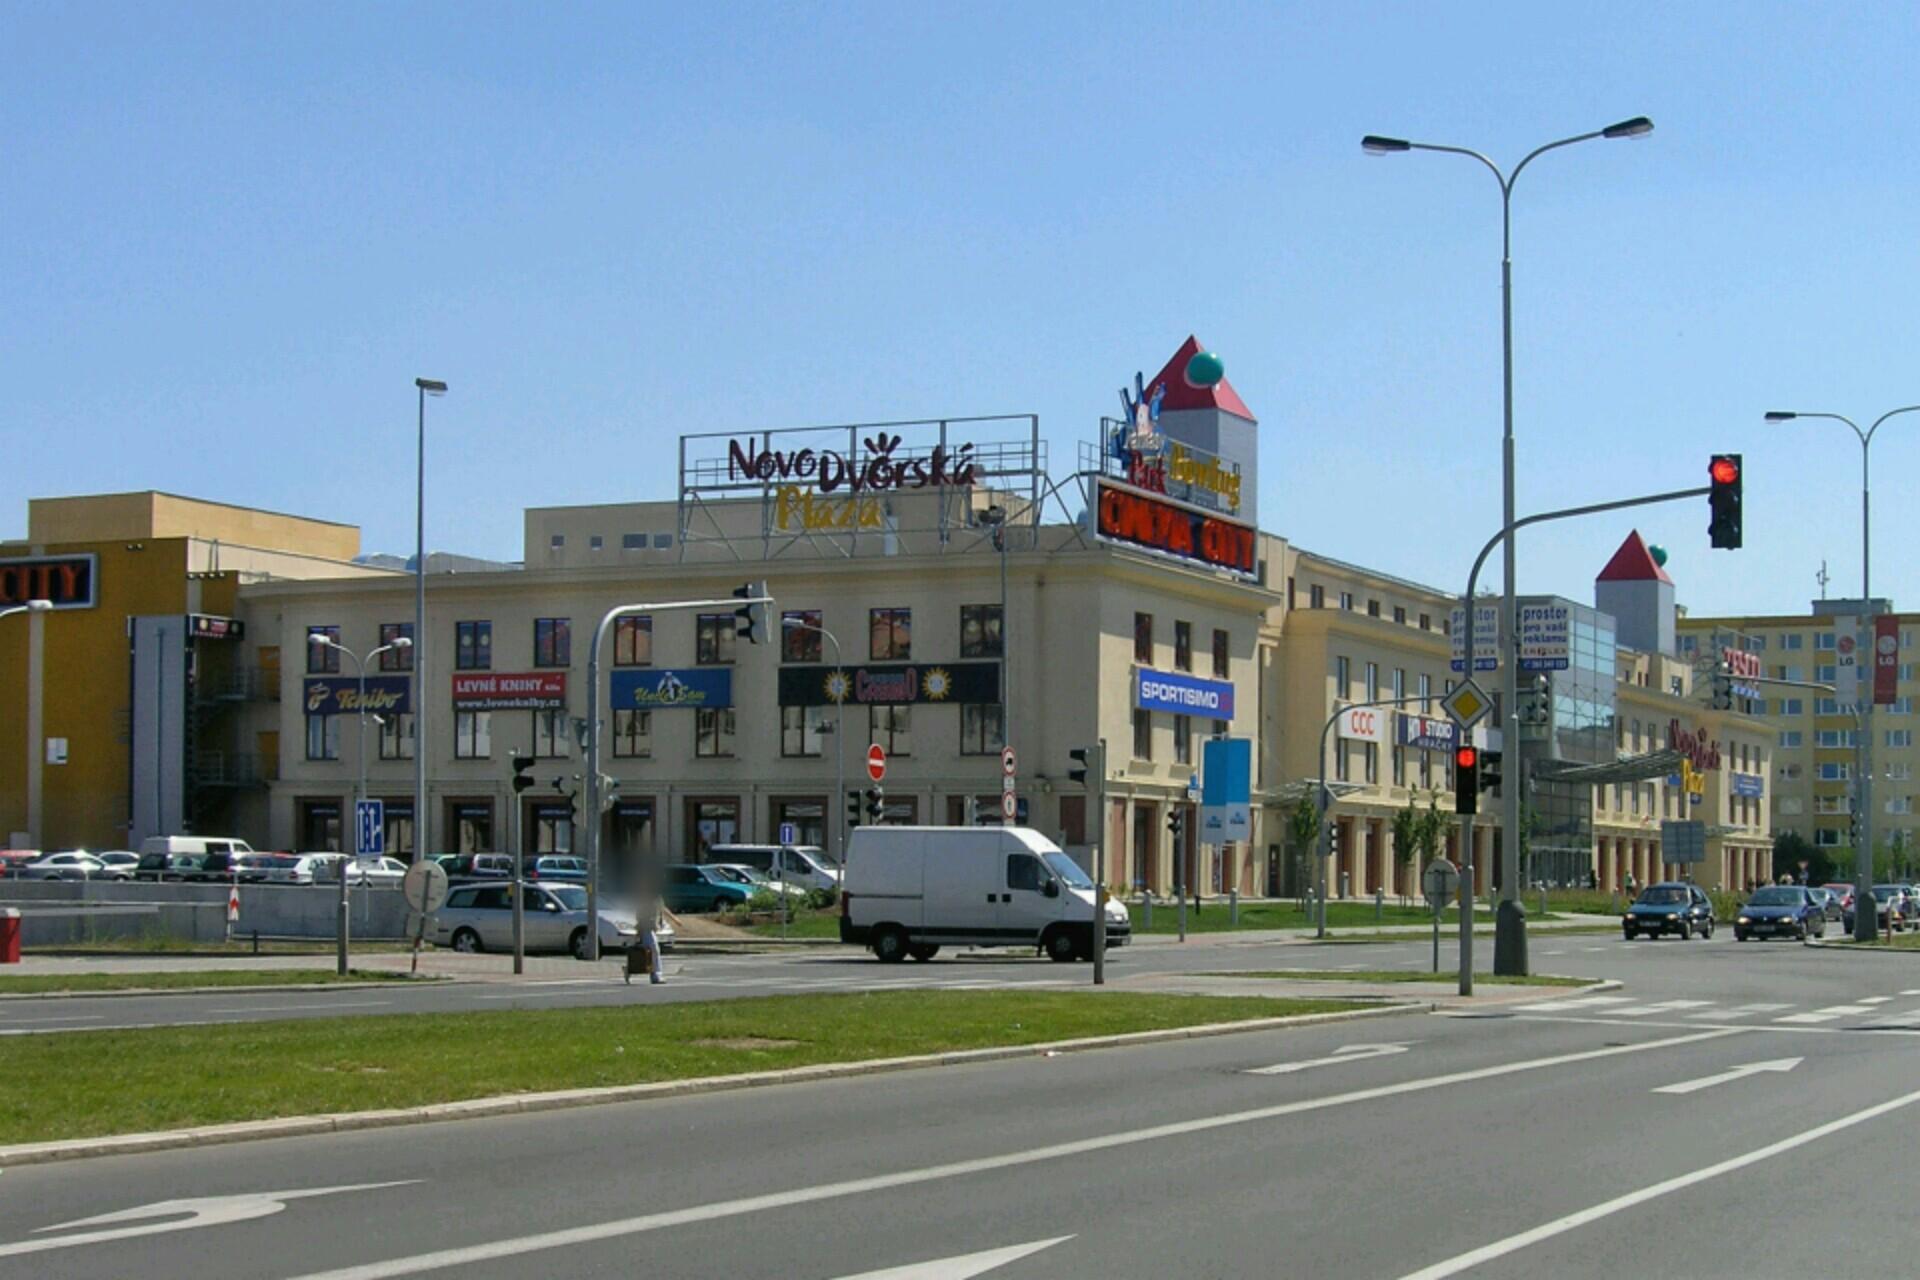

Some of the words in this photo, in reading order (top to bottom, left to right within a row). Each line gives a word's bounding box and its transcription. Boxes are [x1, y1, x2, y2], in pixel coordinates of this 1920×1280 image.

[1523, 608, 1567, 622] prostor
[1523, 623, 1541, 633] pro
[1523, 633, 1567, 643] reklamu
[1839, 657, 1854, 666] LG
[1878, 657, 1895, 666] LG
[456, 676, 497, 693] LEVNÉ
[500, 678, 543, 693] KNIHY
[1141, 681, 1219, 709] SPORTISIMO
[1351, 711, 1375, 736] CCC
